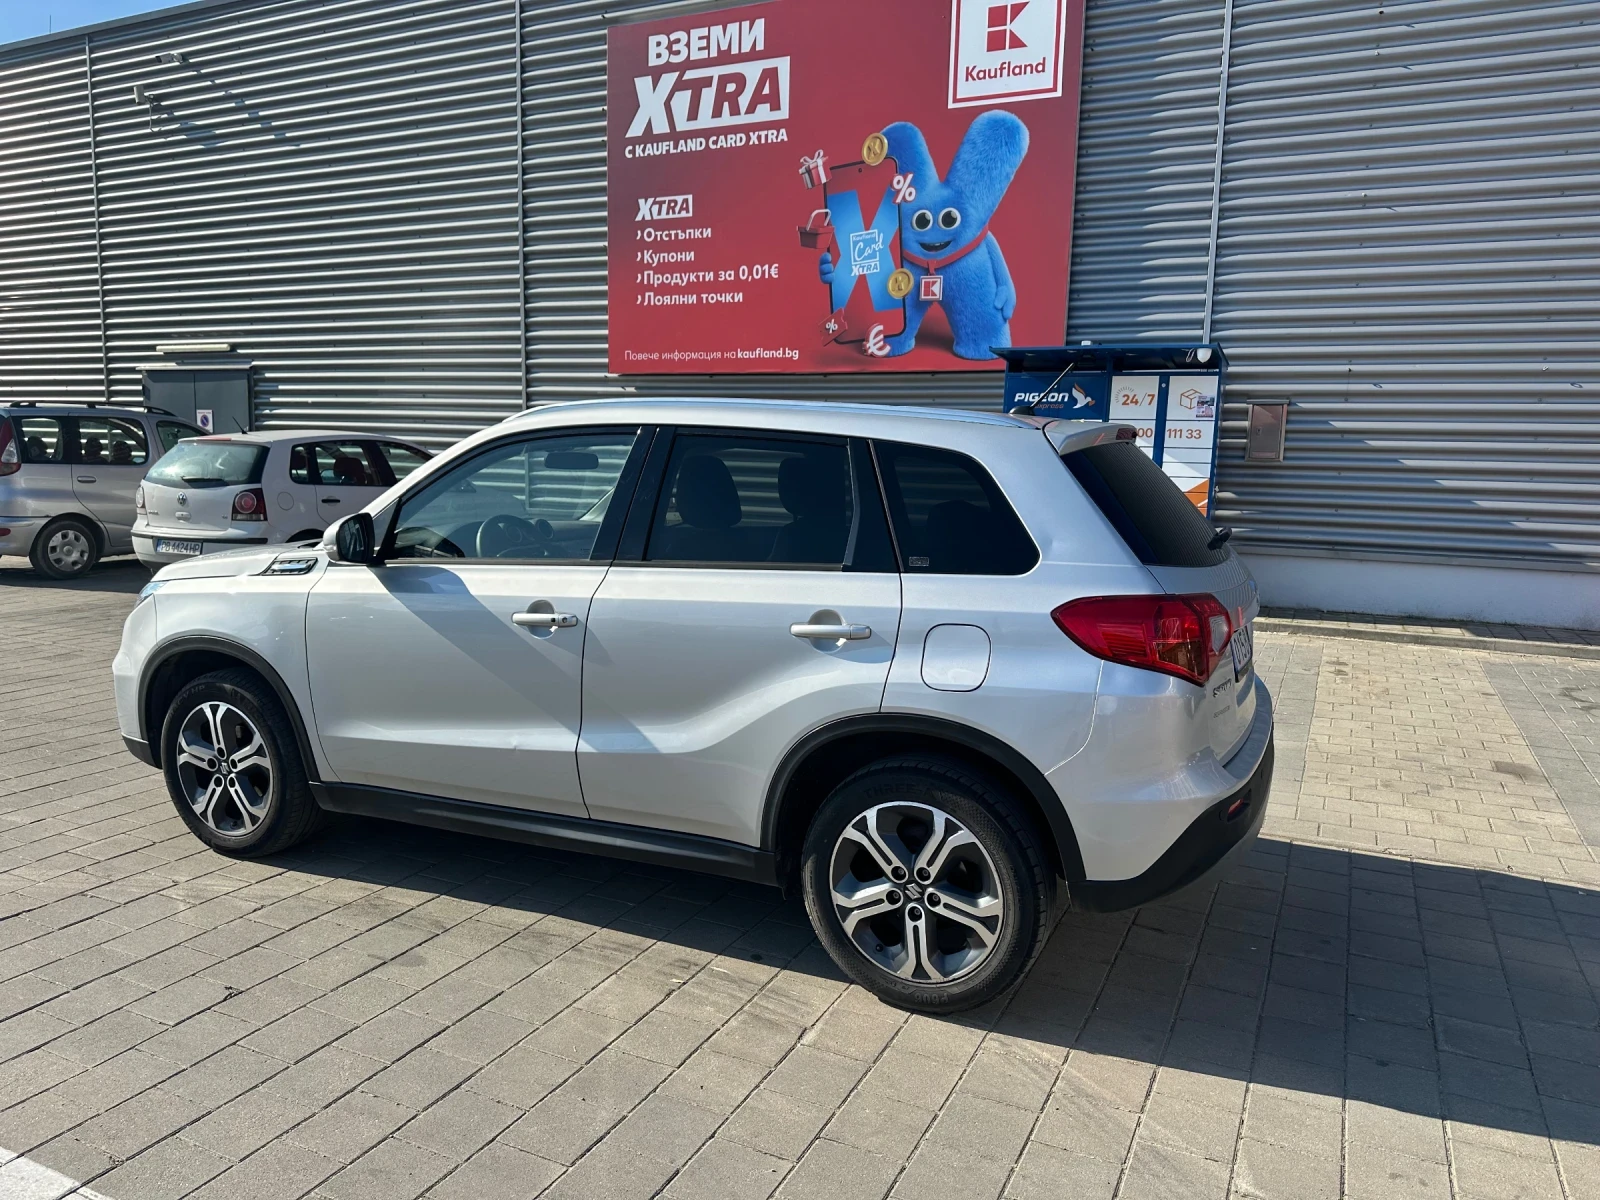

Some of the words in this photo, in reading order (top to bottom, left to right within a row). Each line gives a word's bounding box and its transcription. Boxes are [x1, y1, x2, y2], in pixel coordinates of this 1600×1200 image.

[648, 17, 765, 67] ВЗЕМИ
[964, 56, 1046, 82] Kaufland
[625, 55, 791, 138] XTRA
[635, 137, 706, 158] KAUFLAND
[708, 132, 746, 150] CARD
[749, 128, 788, 146] XTRA
[635, 194, 693, 221] XTRA
[643, 227, 712, 242] Отстъпки
[852, 232, 876, 241] Kaufland
[854, 232, 884, 262] Card
[643, 250, 695, 267] Купони
[643, 270, 714, 287] Продукти
[718, 270, 735, 281] за
[739, 263, 779, 282] 0,01€
[850, 261, 880, 277] XTRA
[643, 292, 697, 306] Лоялни
[701, 291, 743, 304] точки
[624, 350, 660, 361] Повече
[661, 349, 722, 362] информация
[724, 351, 736, 360] на
[737, 347, 799, 361] kaufland.bg
[1121, 392, 1156, 407] 24/7
[1166, 428, 1183, 439] 111
[1185, 428, 1202, 440] 33
